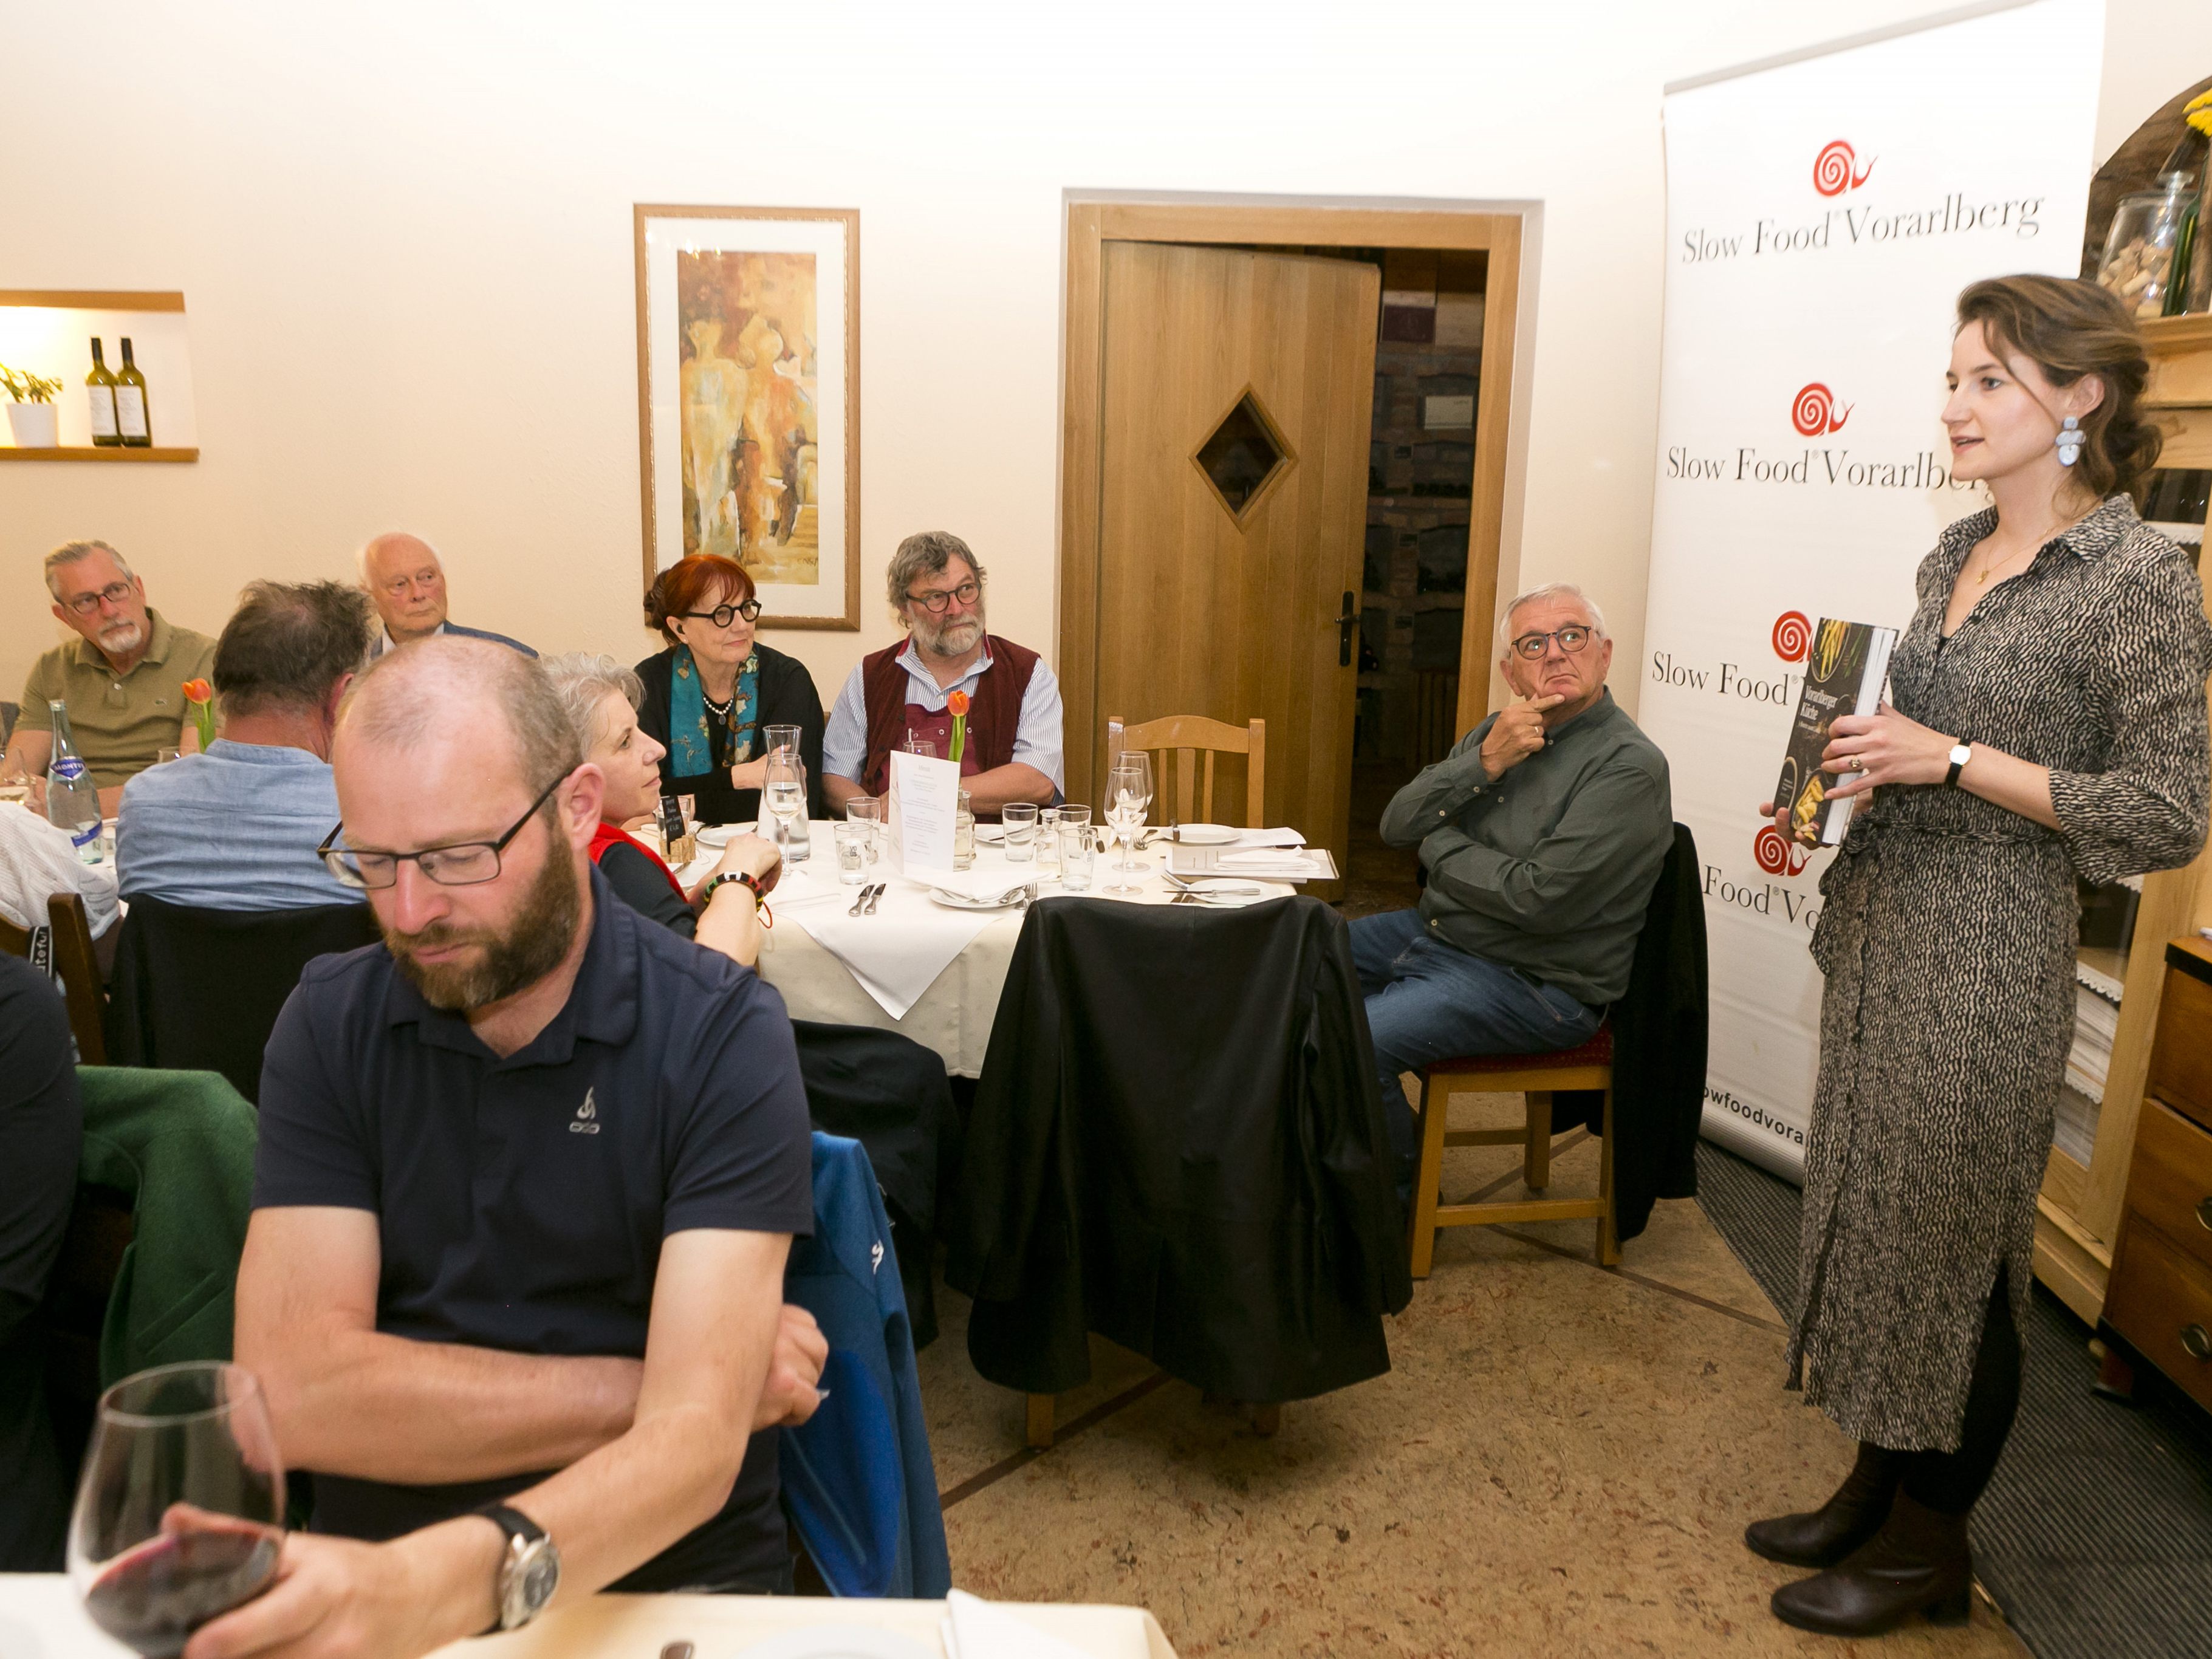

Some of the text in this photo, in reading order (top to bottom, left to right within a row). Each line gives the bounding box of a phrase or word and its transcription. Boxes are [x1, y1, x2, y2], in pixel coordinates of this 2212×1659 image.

[1682, 228, 1744, 264] Slow
[1846, 192, 2045, 244] Vorarlberg
[1667, 446, 1725, 480] Slow
[1652, 651, 1710, 690] Slow
